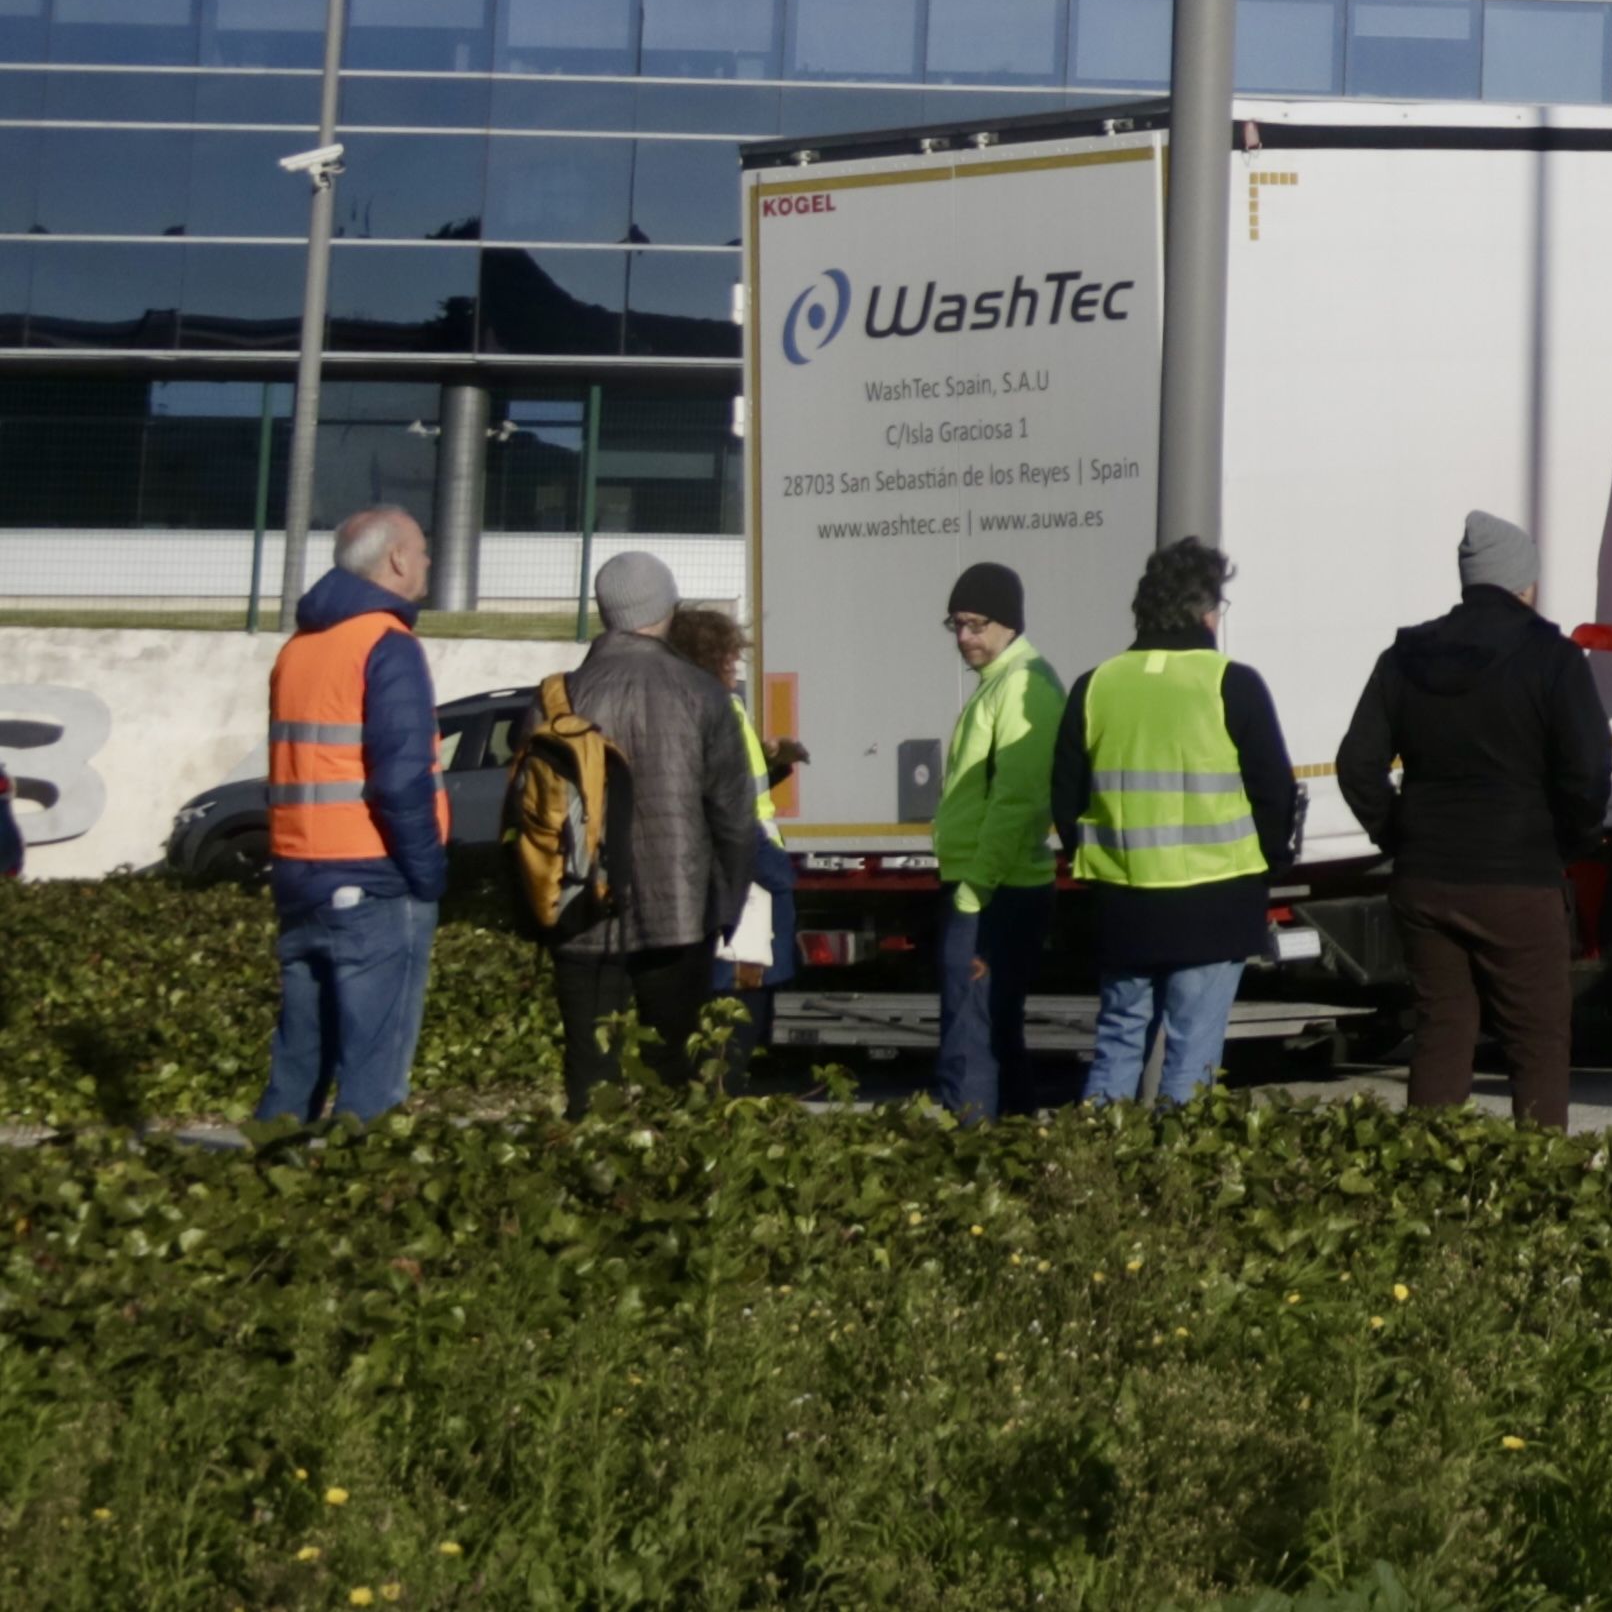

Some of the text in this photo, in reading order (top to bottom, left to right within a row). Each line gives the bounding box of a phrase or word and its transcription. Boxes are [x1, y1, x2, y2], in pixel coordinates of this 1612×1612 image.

[865, 271, 1134, 339] WashTec
[865, 370, 1050, 402] WashTec Spain, S.A.U
[886, 418, 1028, 448] C/Isla Graciosa 1
[783, 457, 1140, 497] 28703 San Sebastián de los Reyes Spain
[818, 509, 1104, 540] www.washtec.es www.auwa.es
